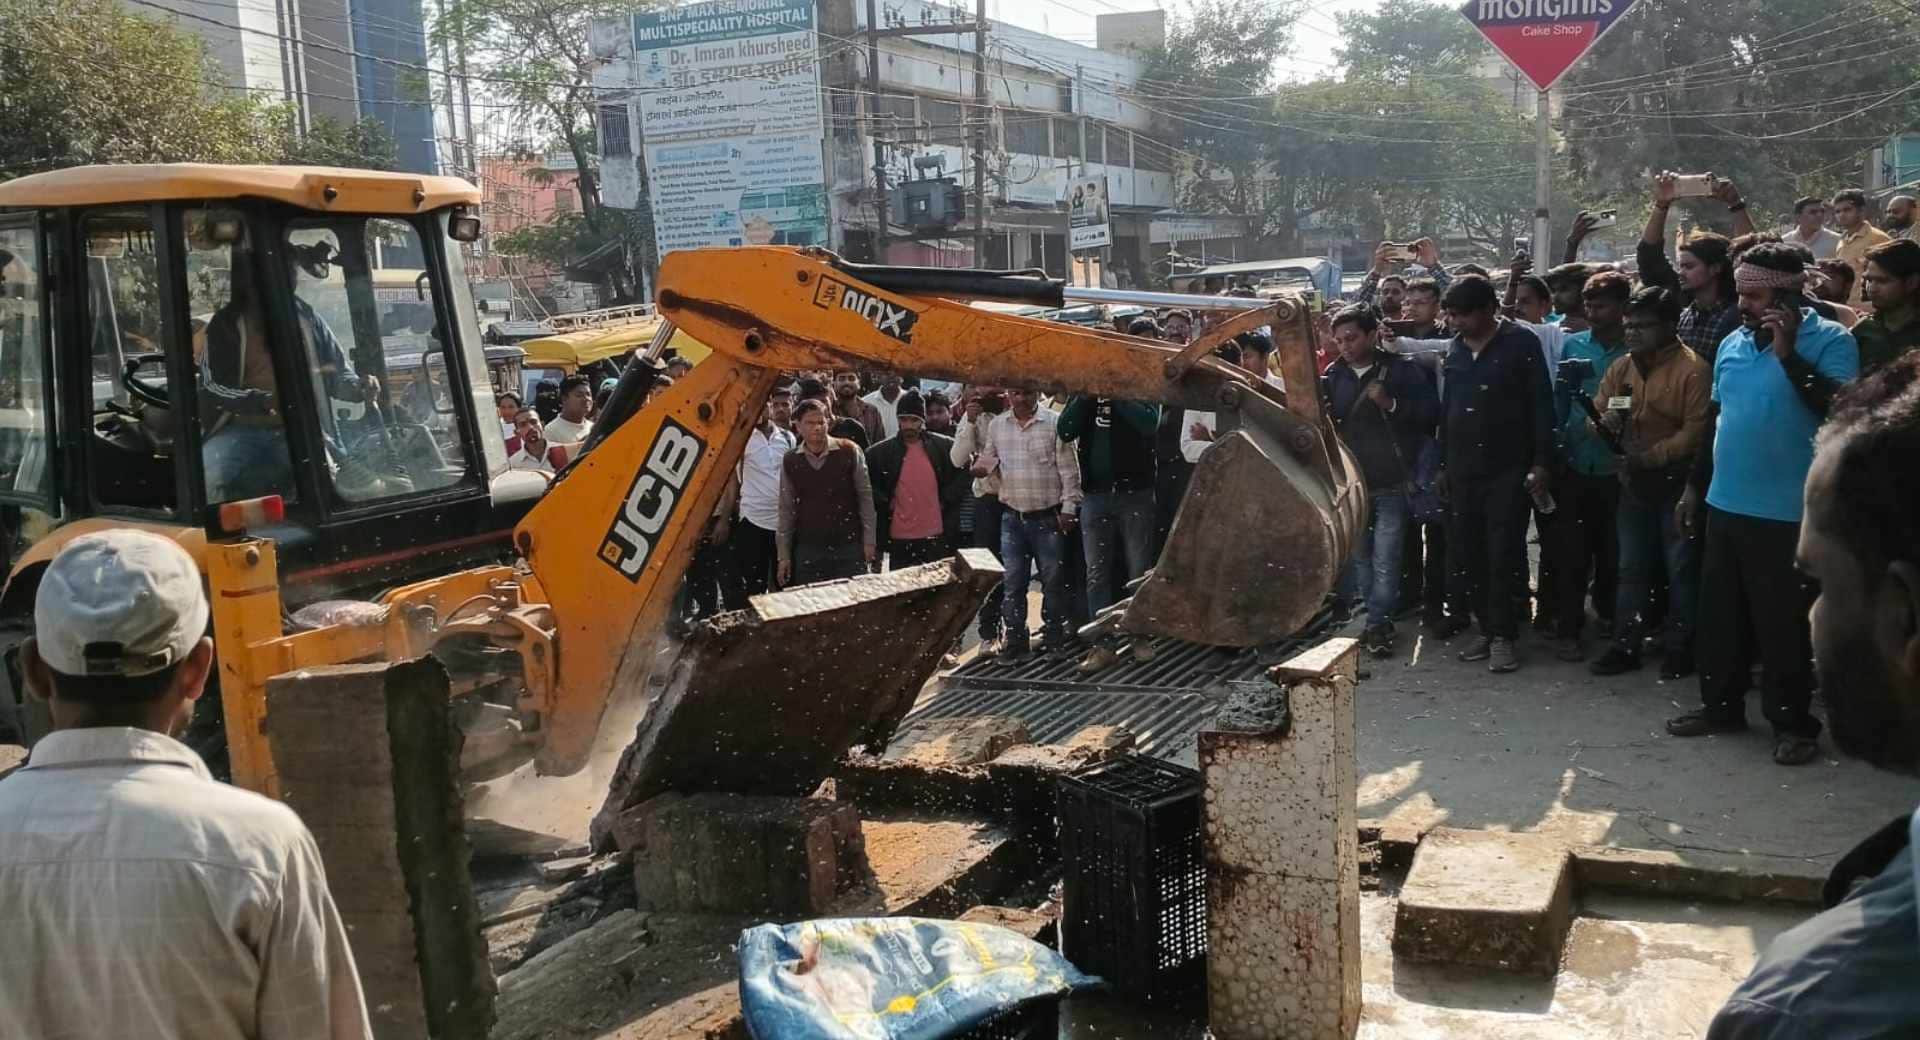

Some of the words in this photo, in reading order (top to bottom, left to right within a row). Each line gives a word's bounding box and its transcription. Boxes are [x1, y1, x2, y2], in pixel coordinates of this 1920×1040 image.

[639, 17, 743, 41] MULTISPECIALITY
[747, 8, 808, 28] HOSPITAL
[687, 4, 715, 19] MAX
[1521, 26, 1550, 37] Cake
[1553, 25, 1583, 37] Shop
[670, 50, 691, 65] Dr.
[695, 46, 735, 62] Imran
[738, 34, 811, 57] khursheed
[613, 425, 701, 575] JCB
